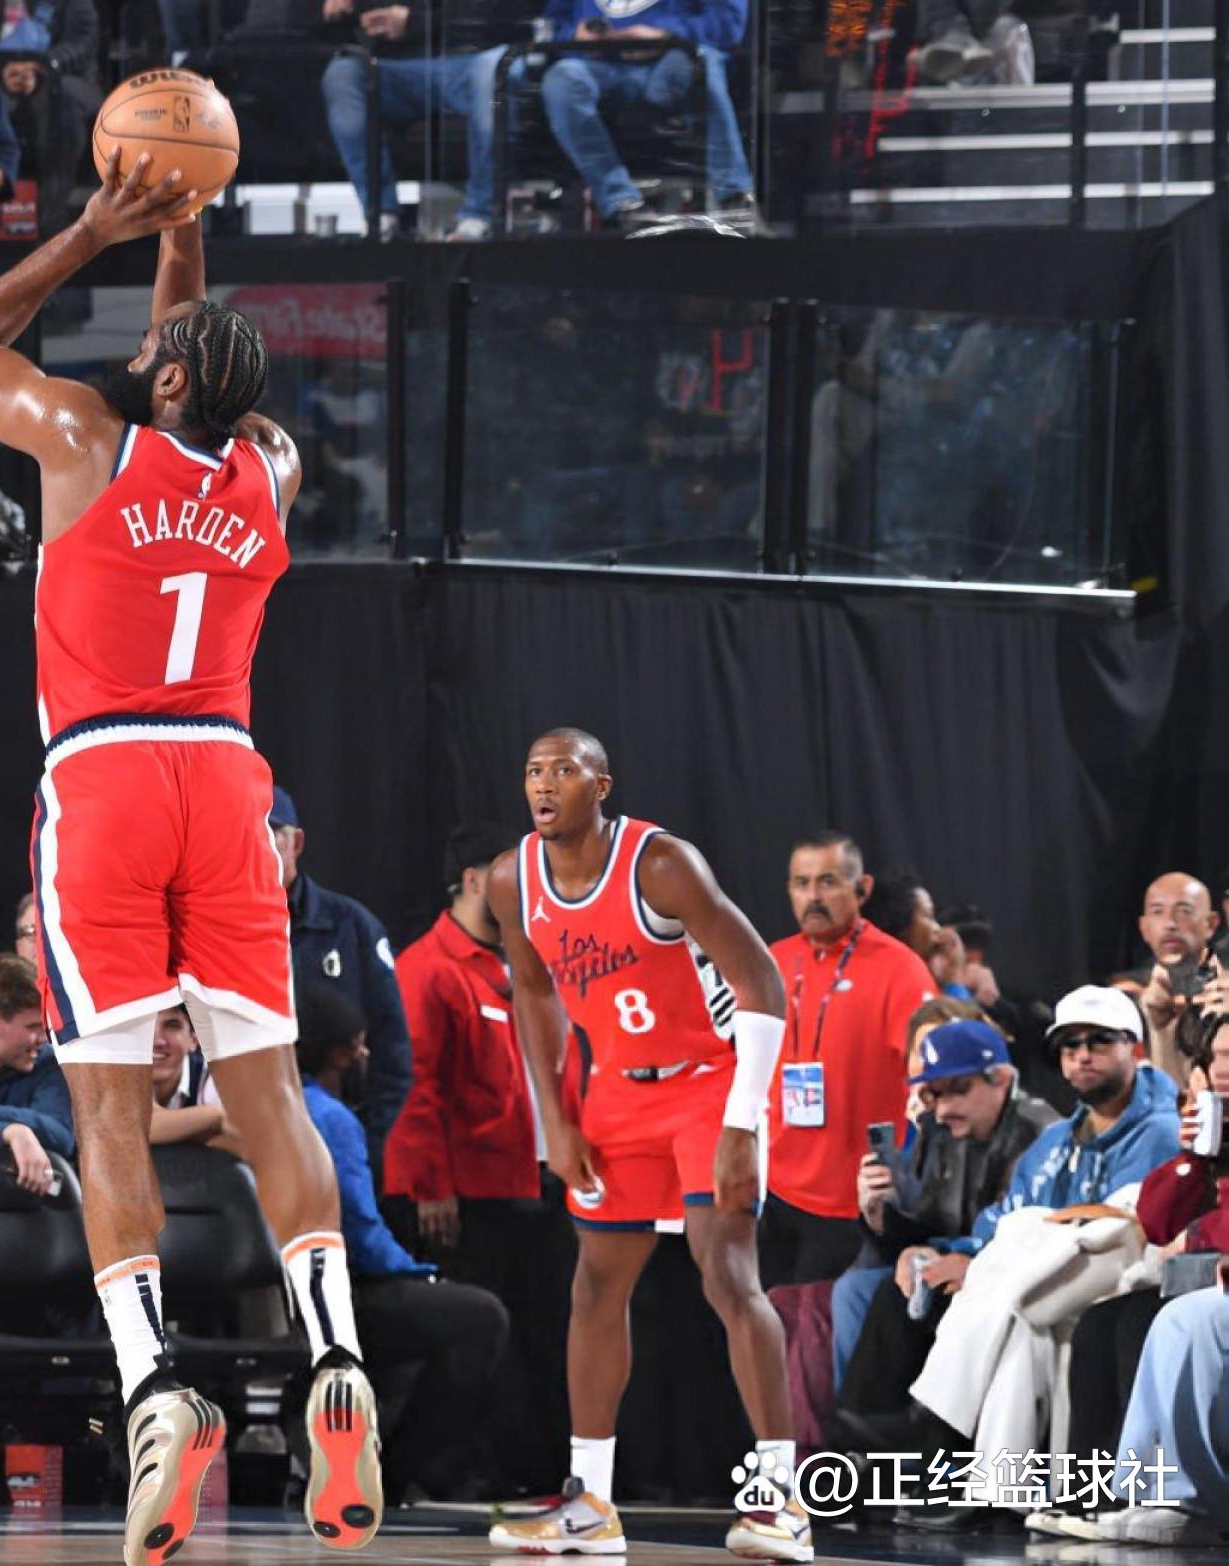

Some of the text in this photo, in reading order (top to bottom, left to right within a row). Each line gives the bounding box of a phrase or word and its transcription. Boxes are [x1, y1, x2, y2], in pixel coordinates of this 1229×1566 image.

[120, 499, 266, 569] HARDEN
[160, 571, 208, 686] 1
[558, 928, 601, 964] Los
[614, 987, 656, 1035] 8
